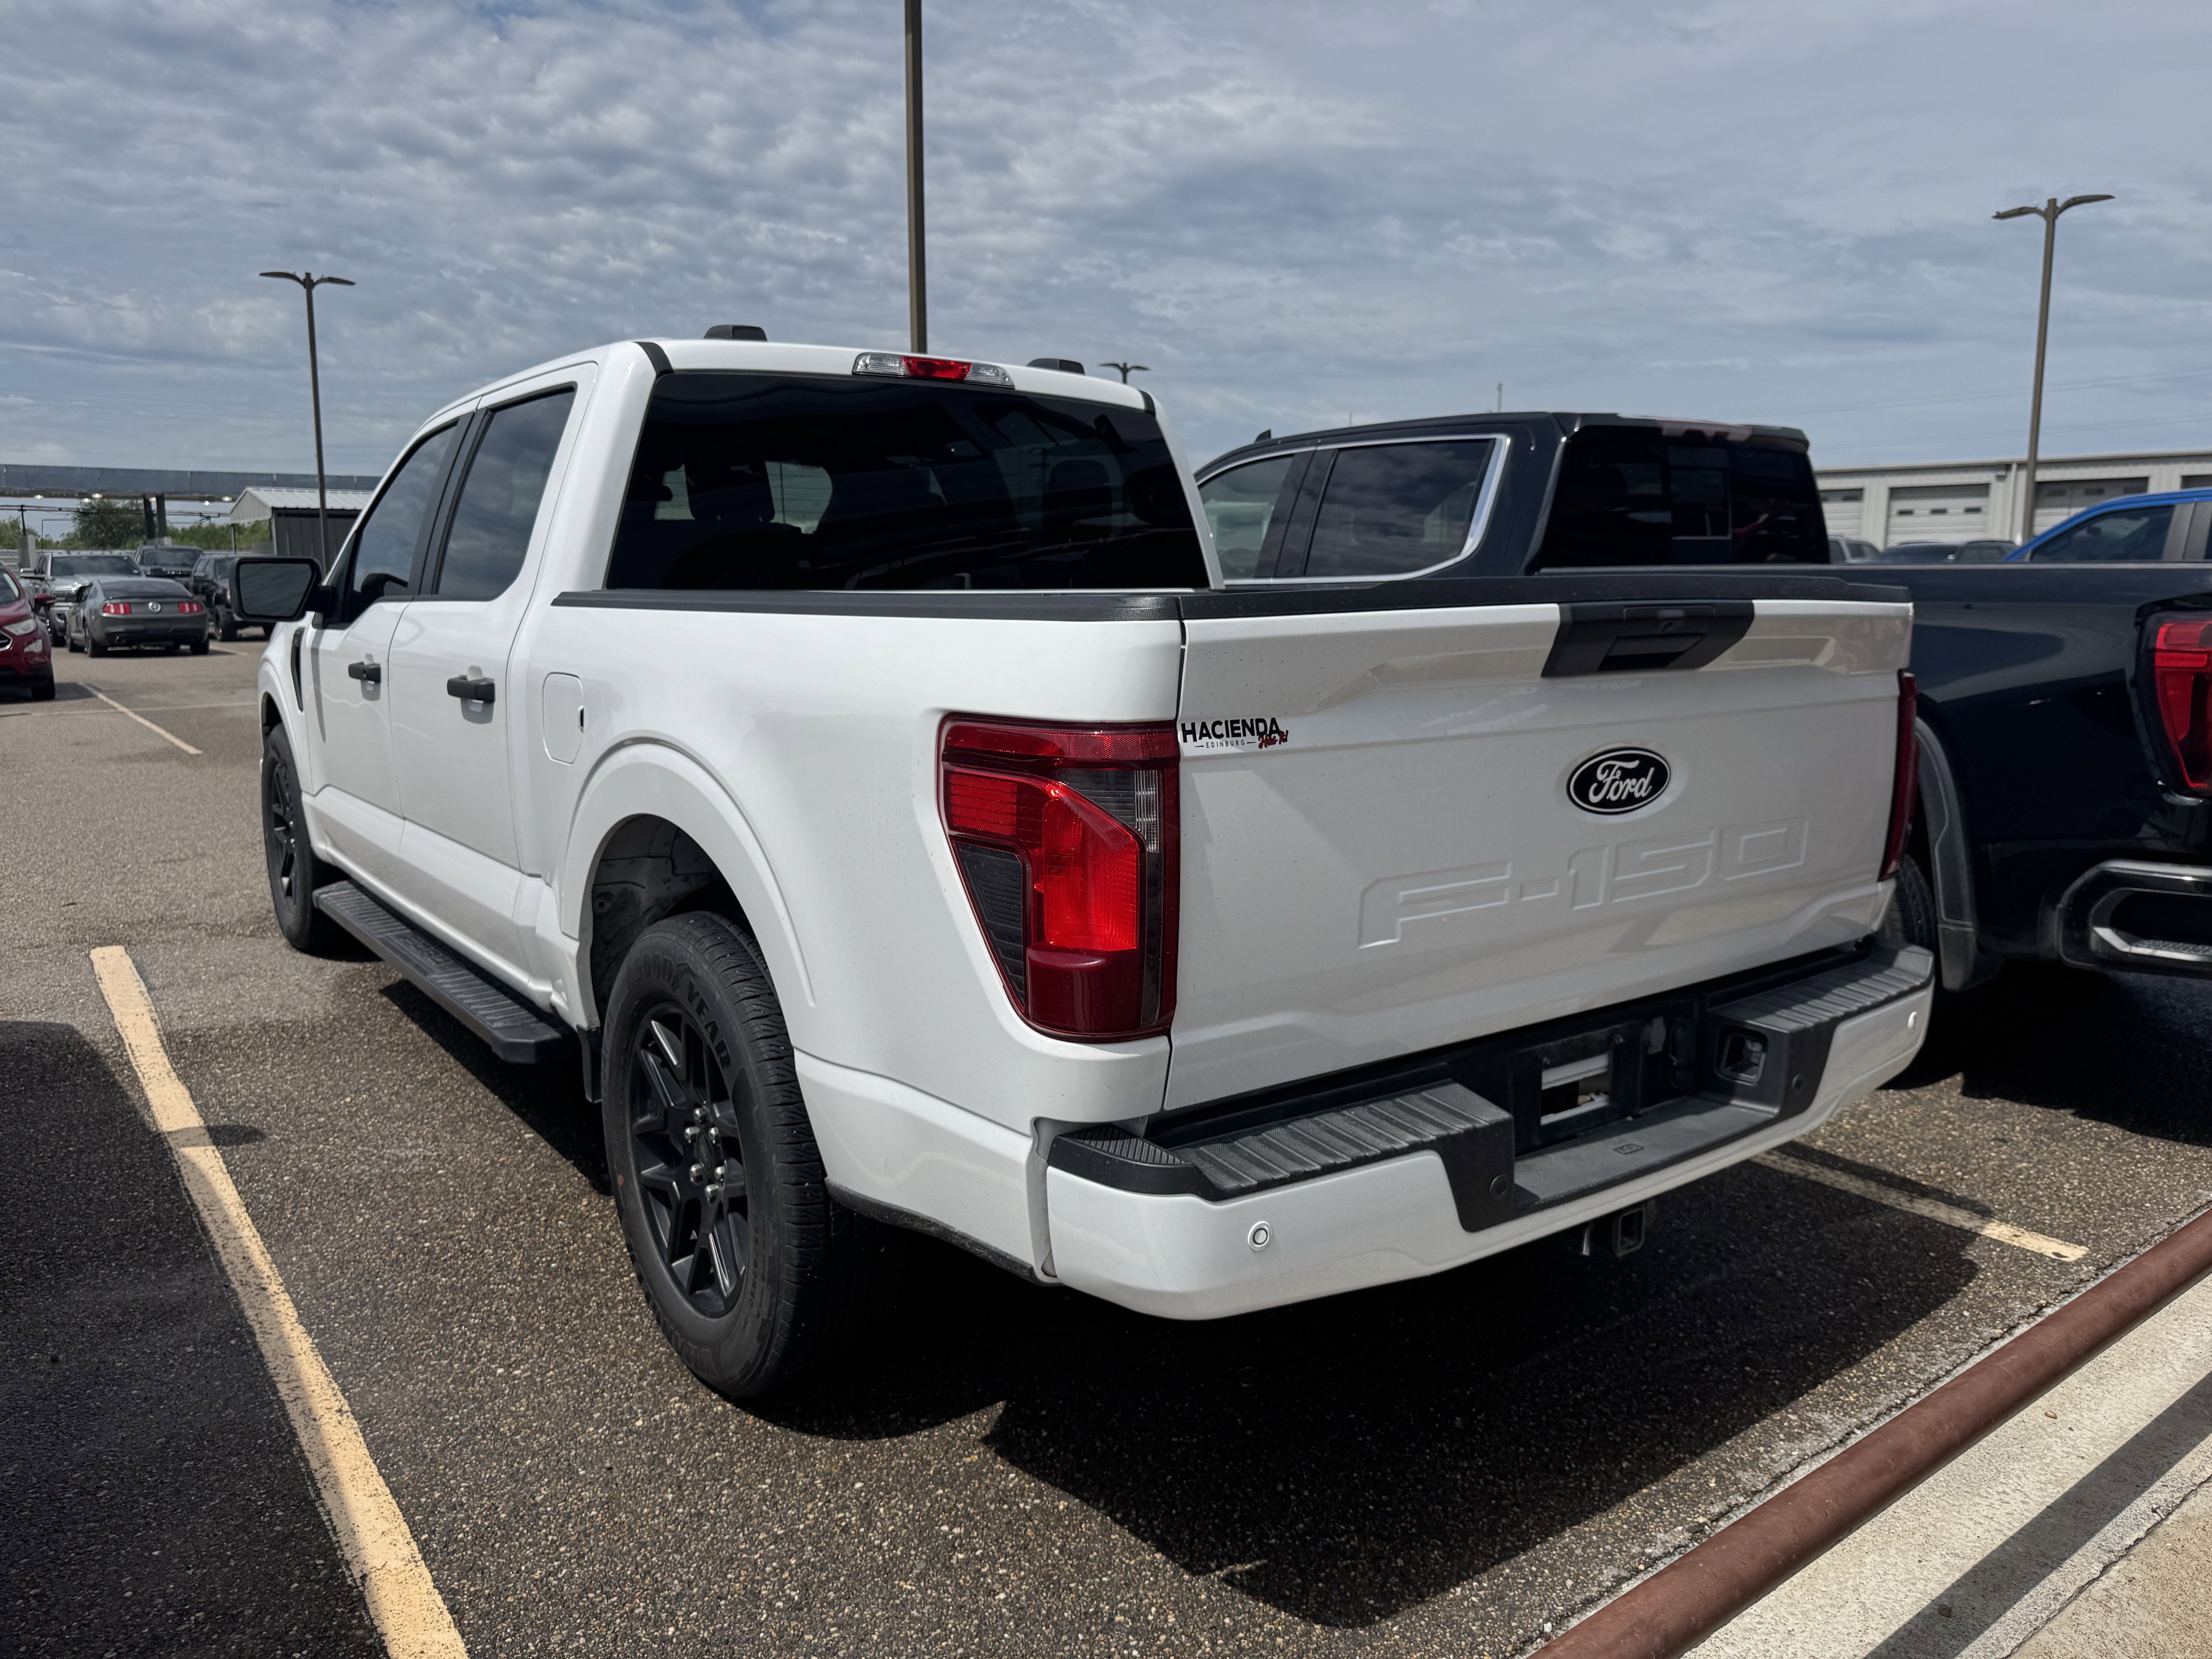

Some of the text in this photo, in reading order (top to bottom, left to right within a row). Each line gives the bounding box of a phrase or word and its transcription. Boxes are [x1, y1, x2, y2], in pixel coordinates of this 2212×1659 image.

[1181, 717, 1280, 743] HACIENDA
[1206, 740, 1245, 748] EDINBURG
[1589, 759, 1655, 803] Ford
[1358, 815, 1808, 948] F-150
